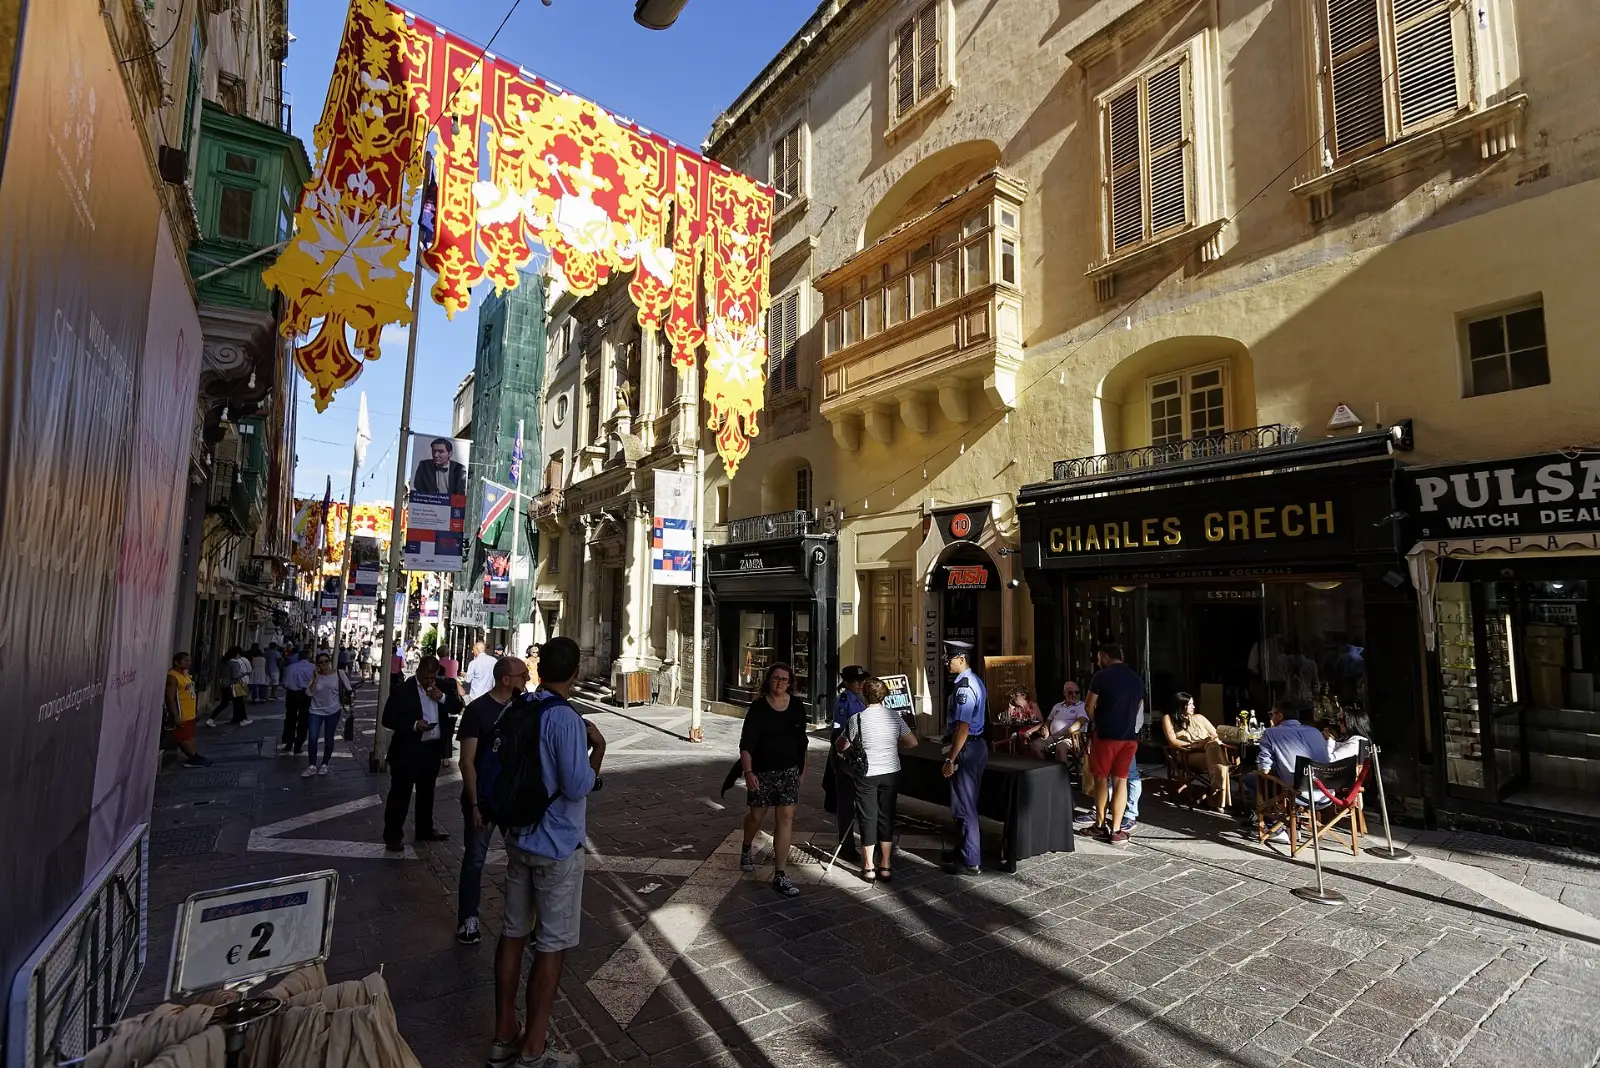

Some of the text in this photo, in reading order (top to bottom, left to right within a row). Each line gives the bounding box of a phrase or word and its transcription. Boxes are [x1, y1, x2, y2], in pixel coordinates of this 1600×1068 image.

[953, 519, 968, 531] 10
[1049, 500, 1335, 553] CHARLES GRECH
[1446, 512, 1520, 529] WATCH
[1422, 528, 1430, 536] 9
[815, 551, 823, 561] 12
[947, 565, 988, 585] rush
[1132, 572, 1161, 580] WINES
[1175, 570, 1213, 578] SPIRITS
[1229, 566, 1293, 577] COCKTAILS
[947, 627, 975, 635] WE ARE
[884, 694, 911, 709] SCHOOL
